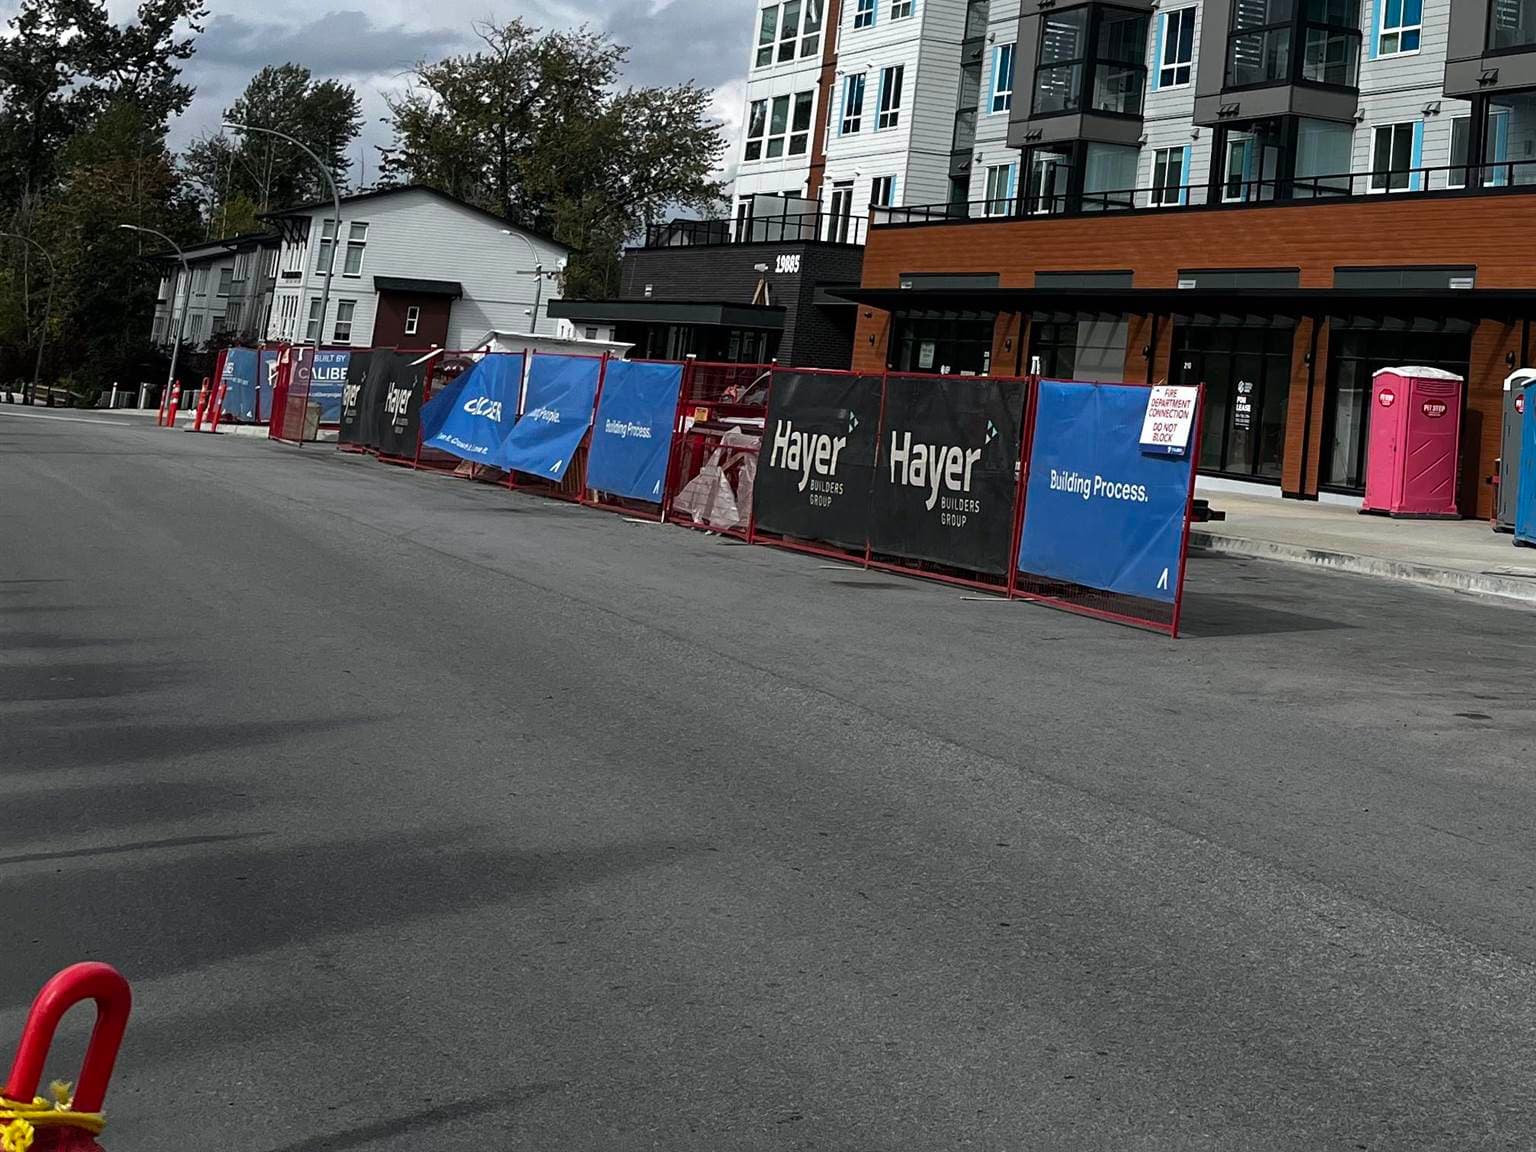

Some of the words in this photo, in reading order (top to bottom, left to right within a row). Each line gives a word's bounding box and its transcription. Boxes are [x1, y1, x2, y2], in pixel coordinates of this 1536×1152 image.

[775, 254, 801, 273] 19885
[299, 367, 348, 380] CALIBE
[1164, 388, 1178, 398] FIRE
[385, 381, 412, 426] Hayer
[1150, 398, 1191, 408] DEPARTMENT
[1148, 408, 1189, 419] CONNECTION
[605, 419, 628, 438] Building
[1153, 422, 1163, 432] DO
[1163, 423, 1178, 432] NOT
[1152, 433, 1174, 442] BLOCK
[770, 419, 847, 492] Hayer
[890, 430, 982, 511] Hayer
[810, 479, 844, 495] BUILDERS
[1050, 469, 1091, 500] Building
[1093, 475, 1148, 502] Process.
[809, 494, 832, 508] GROUP
[941, 496, 980, 513] BUILDERS
[941, 512, 967, 528] GROUP
